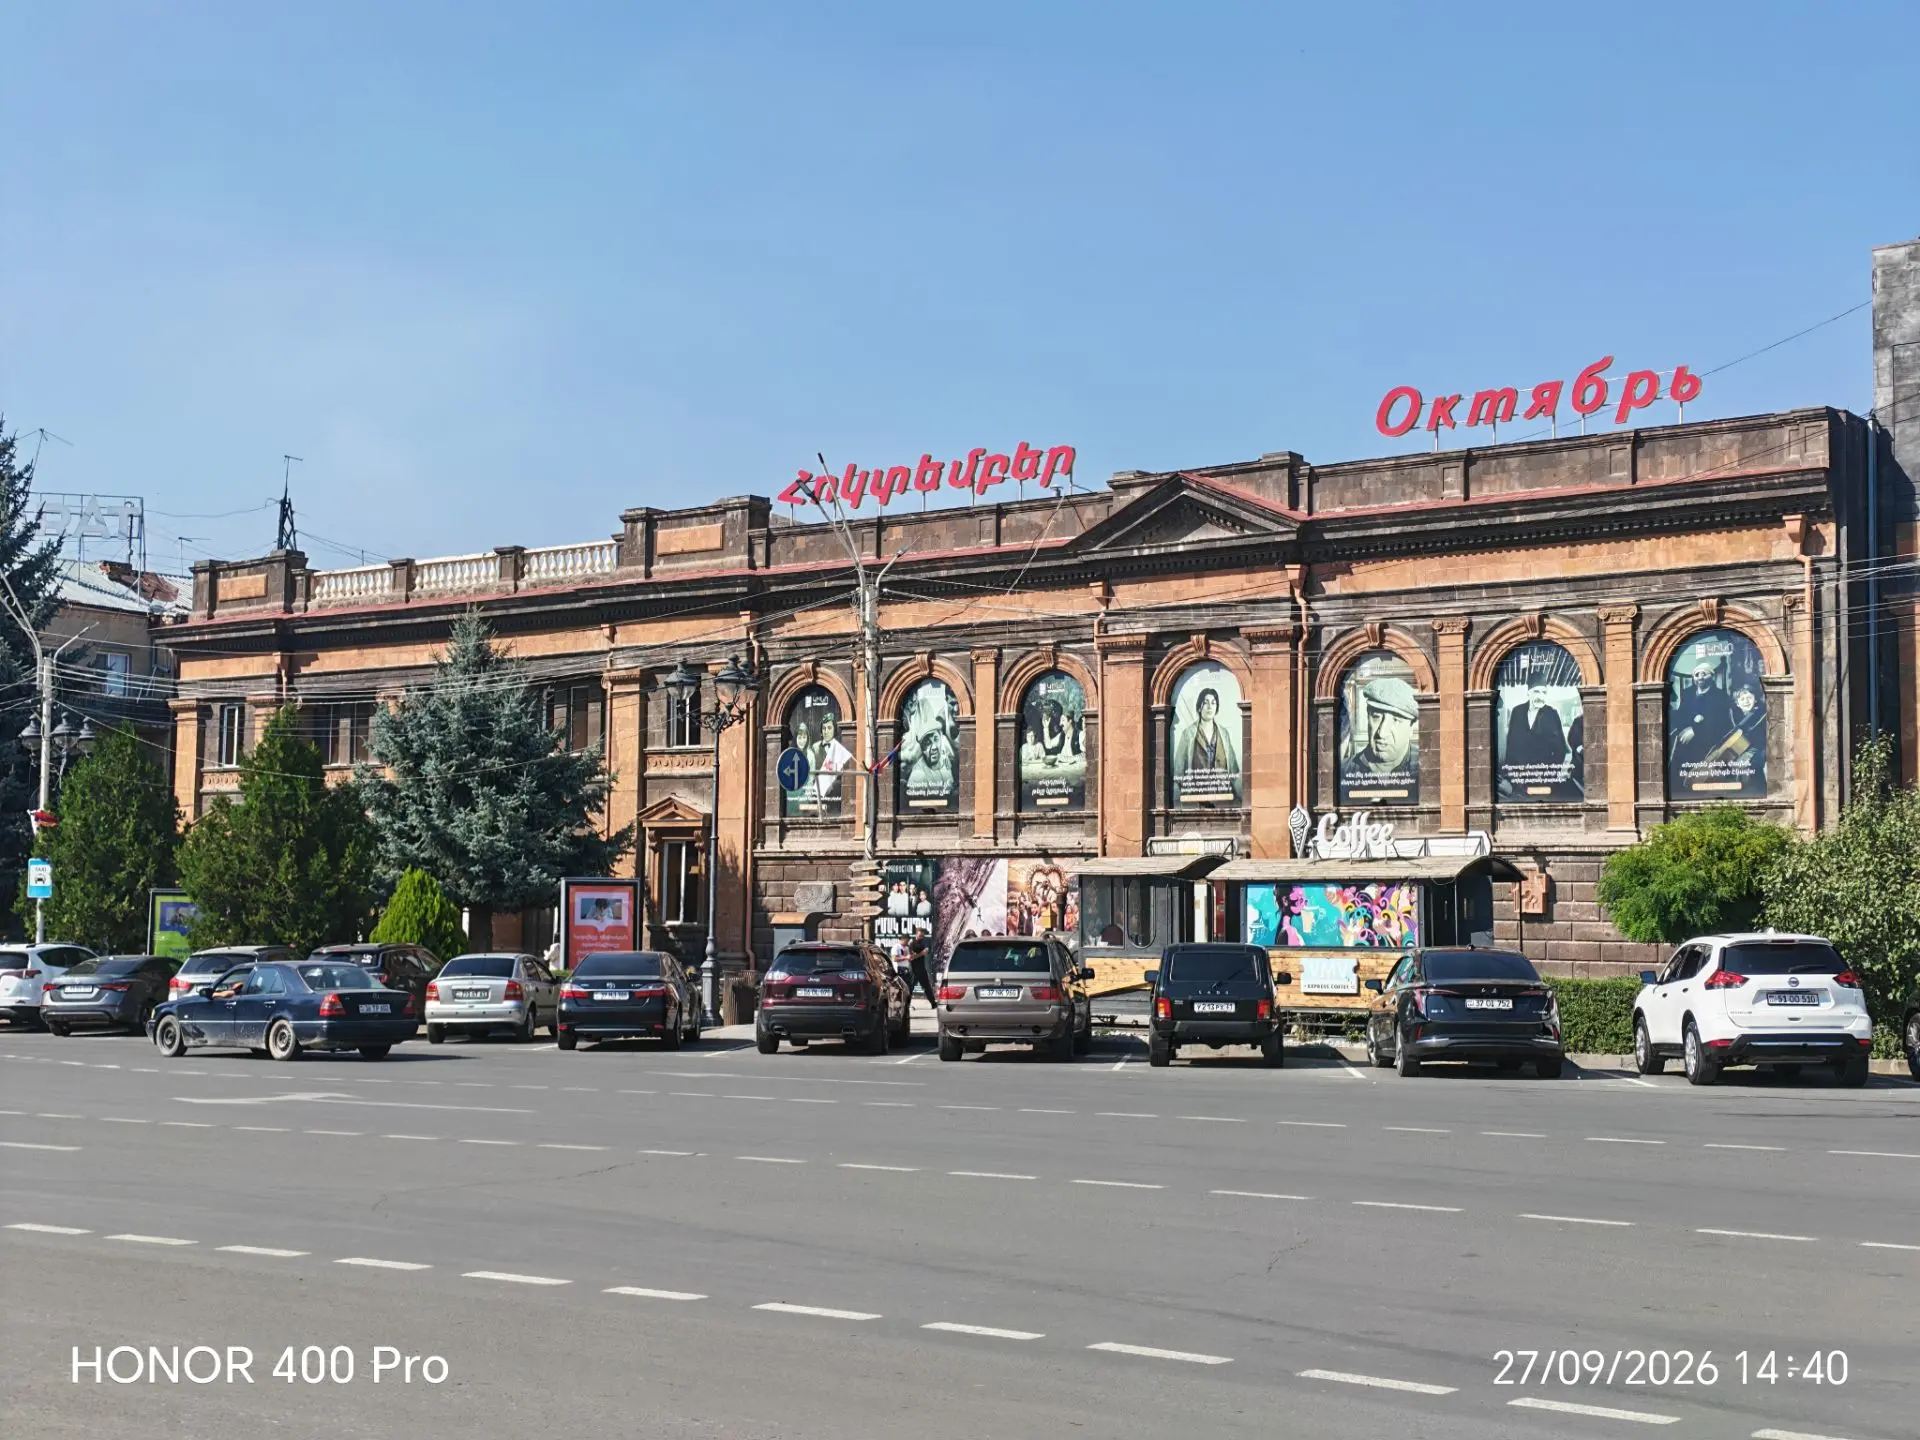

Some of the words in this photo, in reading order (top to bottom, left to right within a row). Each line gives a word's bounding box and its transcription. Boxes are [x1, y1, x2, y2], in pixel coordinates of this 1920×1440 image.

[1375, 355, 1702, 438] Октябрь
[777, 441, 1076, 509] Հոկտեմբեր
[1312, 811, 1395, 855] Coffee
[1801, 995, 1815, 1003] 510
